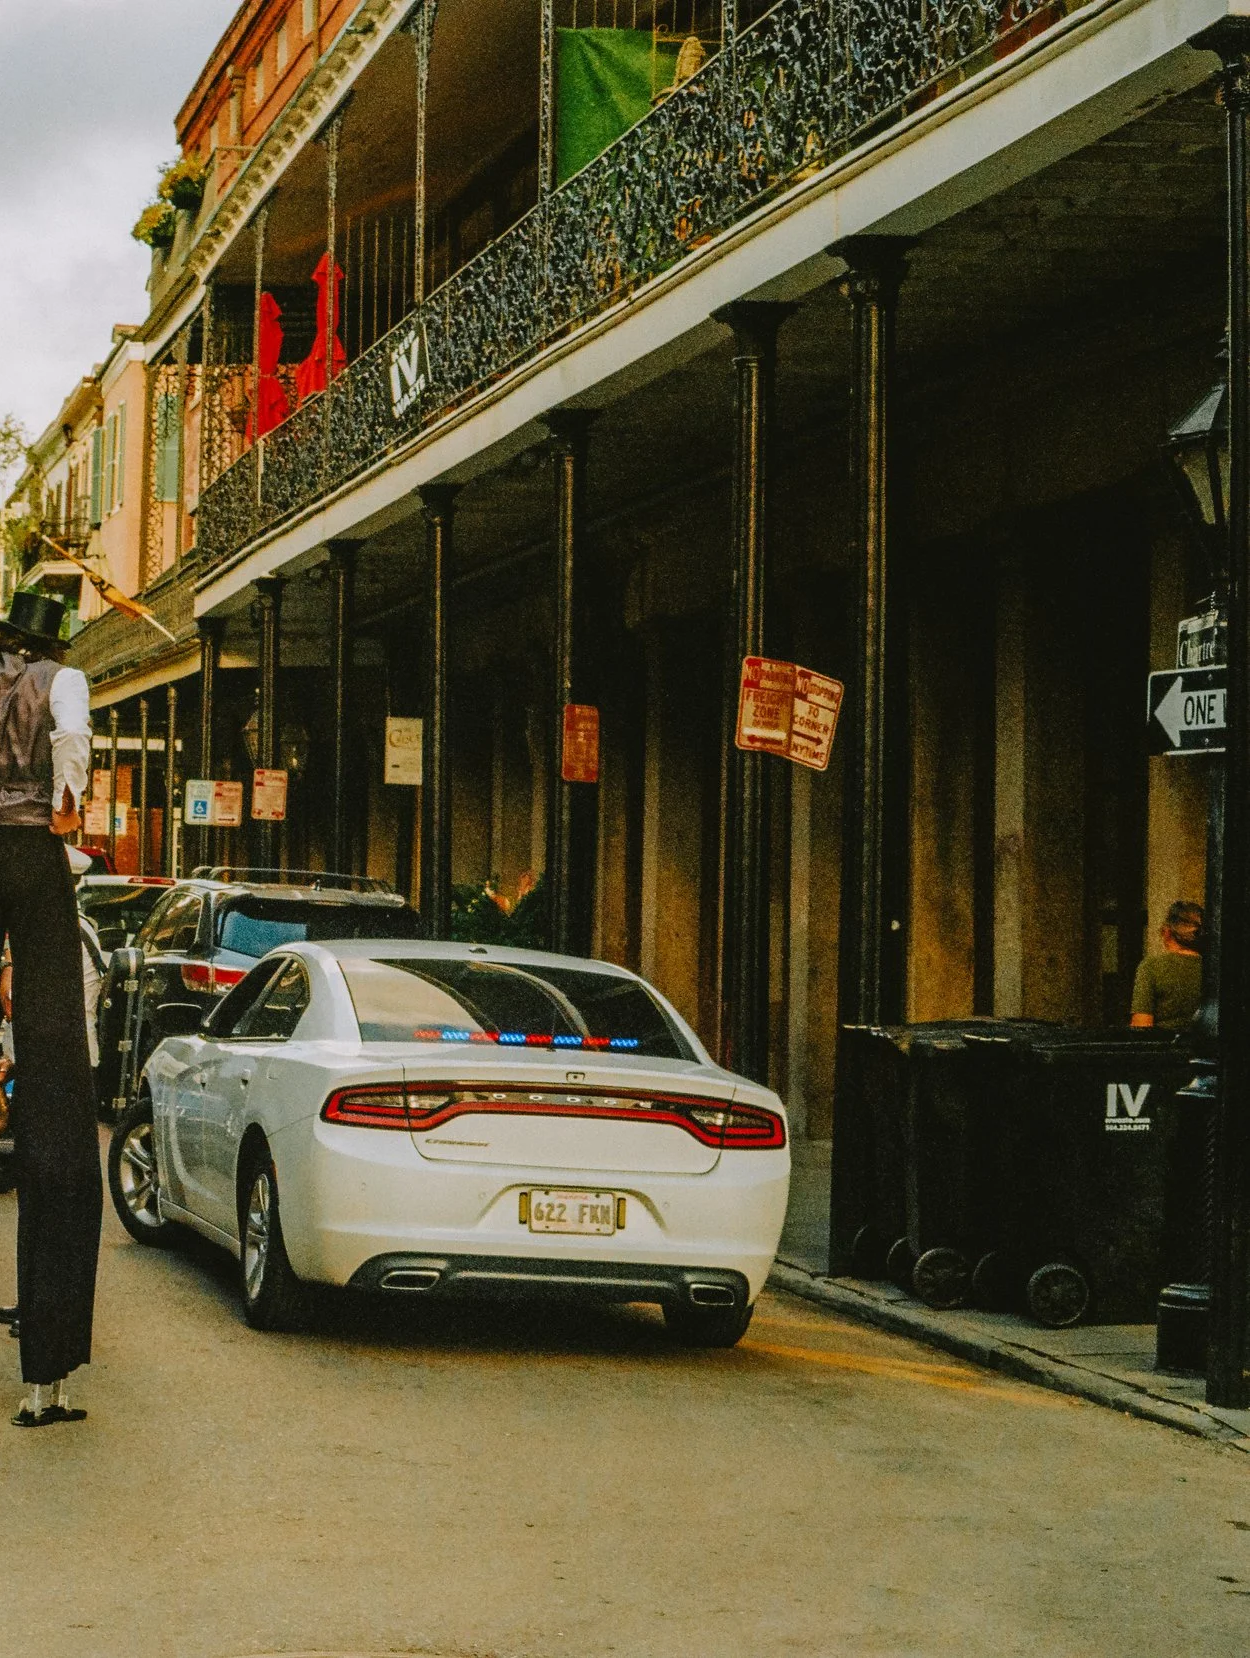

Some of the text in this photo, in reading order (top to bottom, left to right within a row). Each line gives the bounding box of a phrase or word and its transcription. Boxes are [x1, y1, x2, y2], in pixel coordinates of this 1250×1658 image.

[390, 336, 419, 404] IV
[795, 677, 808, 694] NO
[752, 705, 781, 719] ZONE
[808, 704, 820, 718] TO
[1184, 694, 1217, 726] ONE
[793, 715, 830, 735] CORNER
[1106, 1083, 1151, 1117] IV
[533, 1202, 568, 1223] 622
